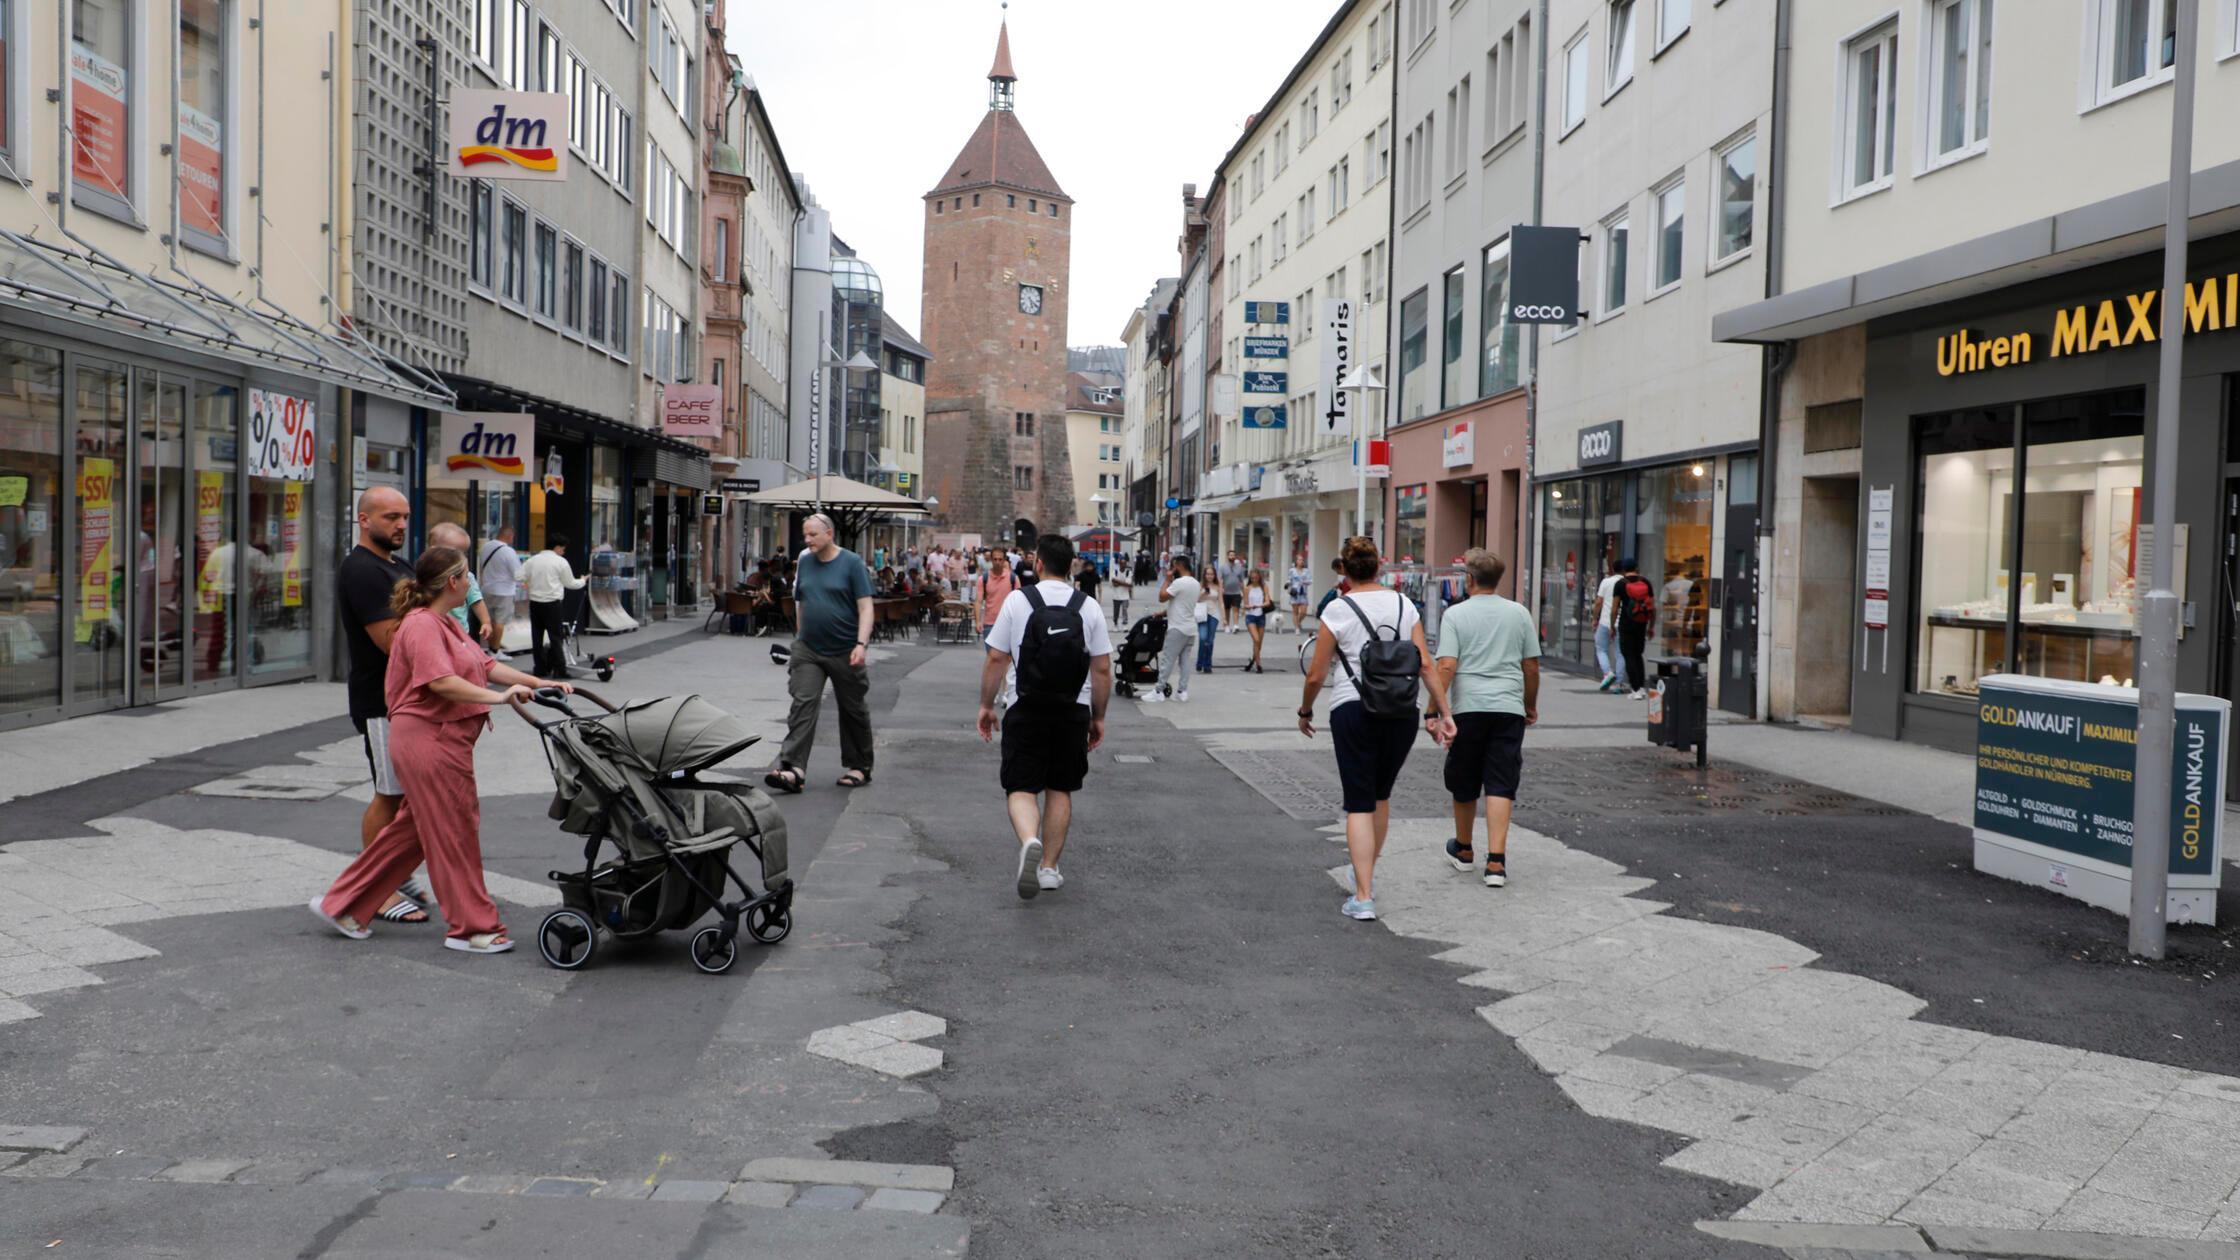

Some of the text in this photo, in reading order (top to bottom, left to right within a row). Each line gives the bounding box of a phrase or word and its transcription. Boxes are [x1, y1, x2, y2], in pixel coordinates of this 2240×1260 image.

[476, 104, 547, 146] dm
[1514, 305, 1565, 319] ecco
[1937, 329, 2031, 377] Uhren
[667, 414, 710, 425] BEER
[460, 422, 517, 456] dm
[1581, 430, 1611, 459] ecco
[84, 476, 111, 501] SSV
[201, 486, 221, 510] SSV
[1980, 704, 2074, 735] GOLDANKAUF
[1978, 757, 2093, 788] GOLDHÄNDLER IN NÜRNBERG.
[1979, 744, 2133, 782] IHR PERSÖNLICHER UND KOMPETENTER
[1977, 788, 2008, 803] ALTGOLD
[2021, 798, 2078, 820] GOLDSCHMUCK
[2182, 722, 2206, 859] GOLDANKAUF
[1976, 800, 2020, 819] GOLDUHREN
[2033, 813, 2078, 833] DIAMANTEN
